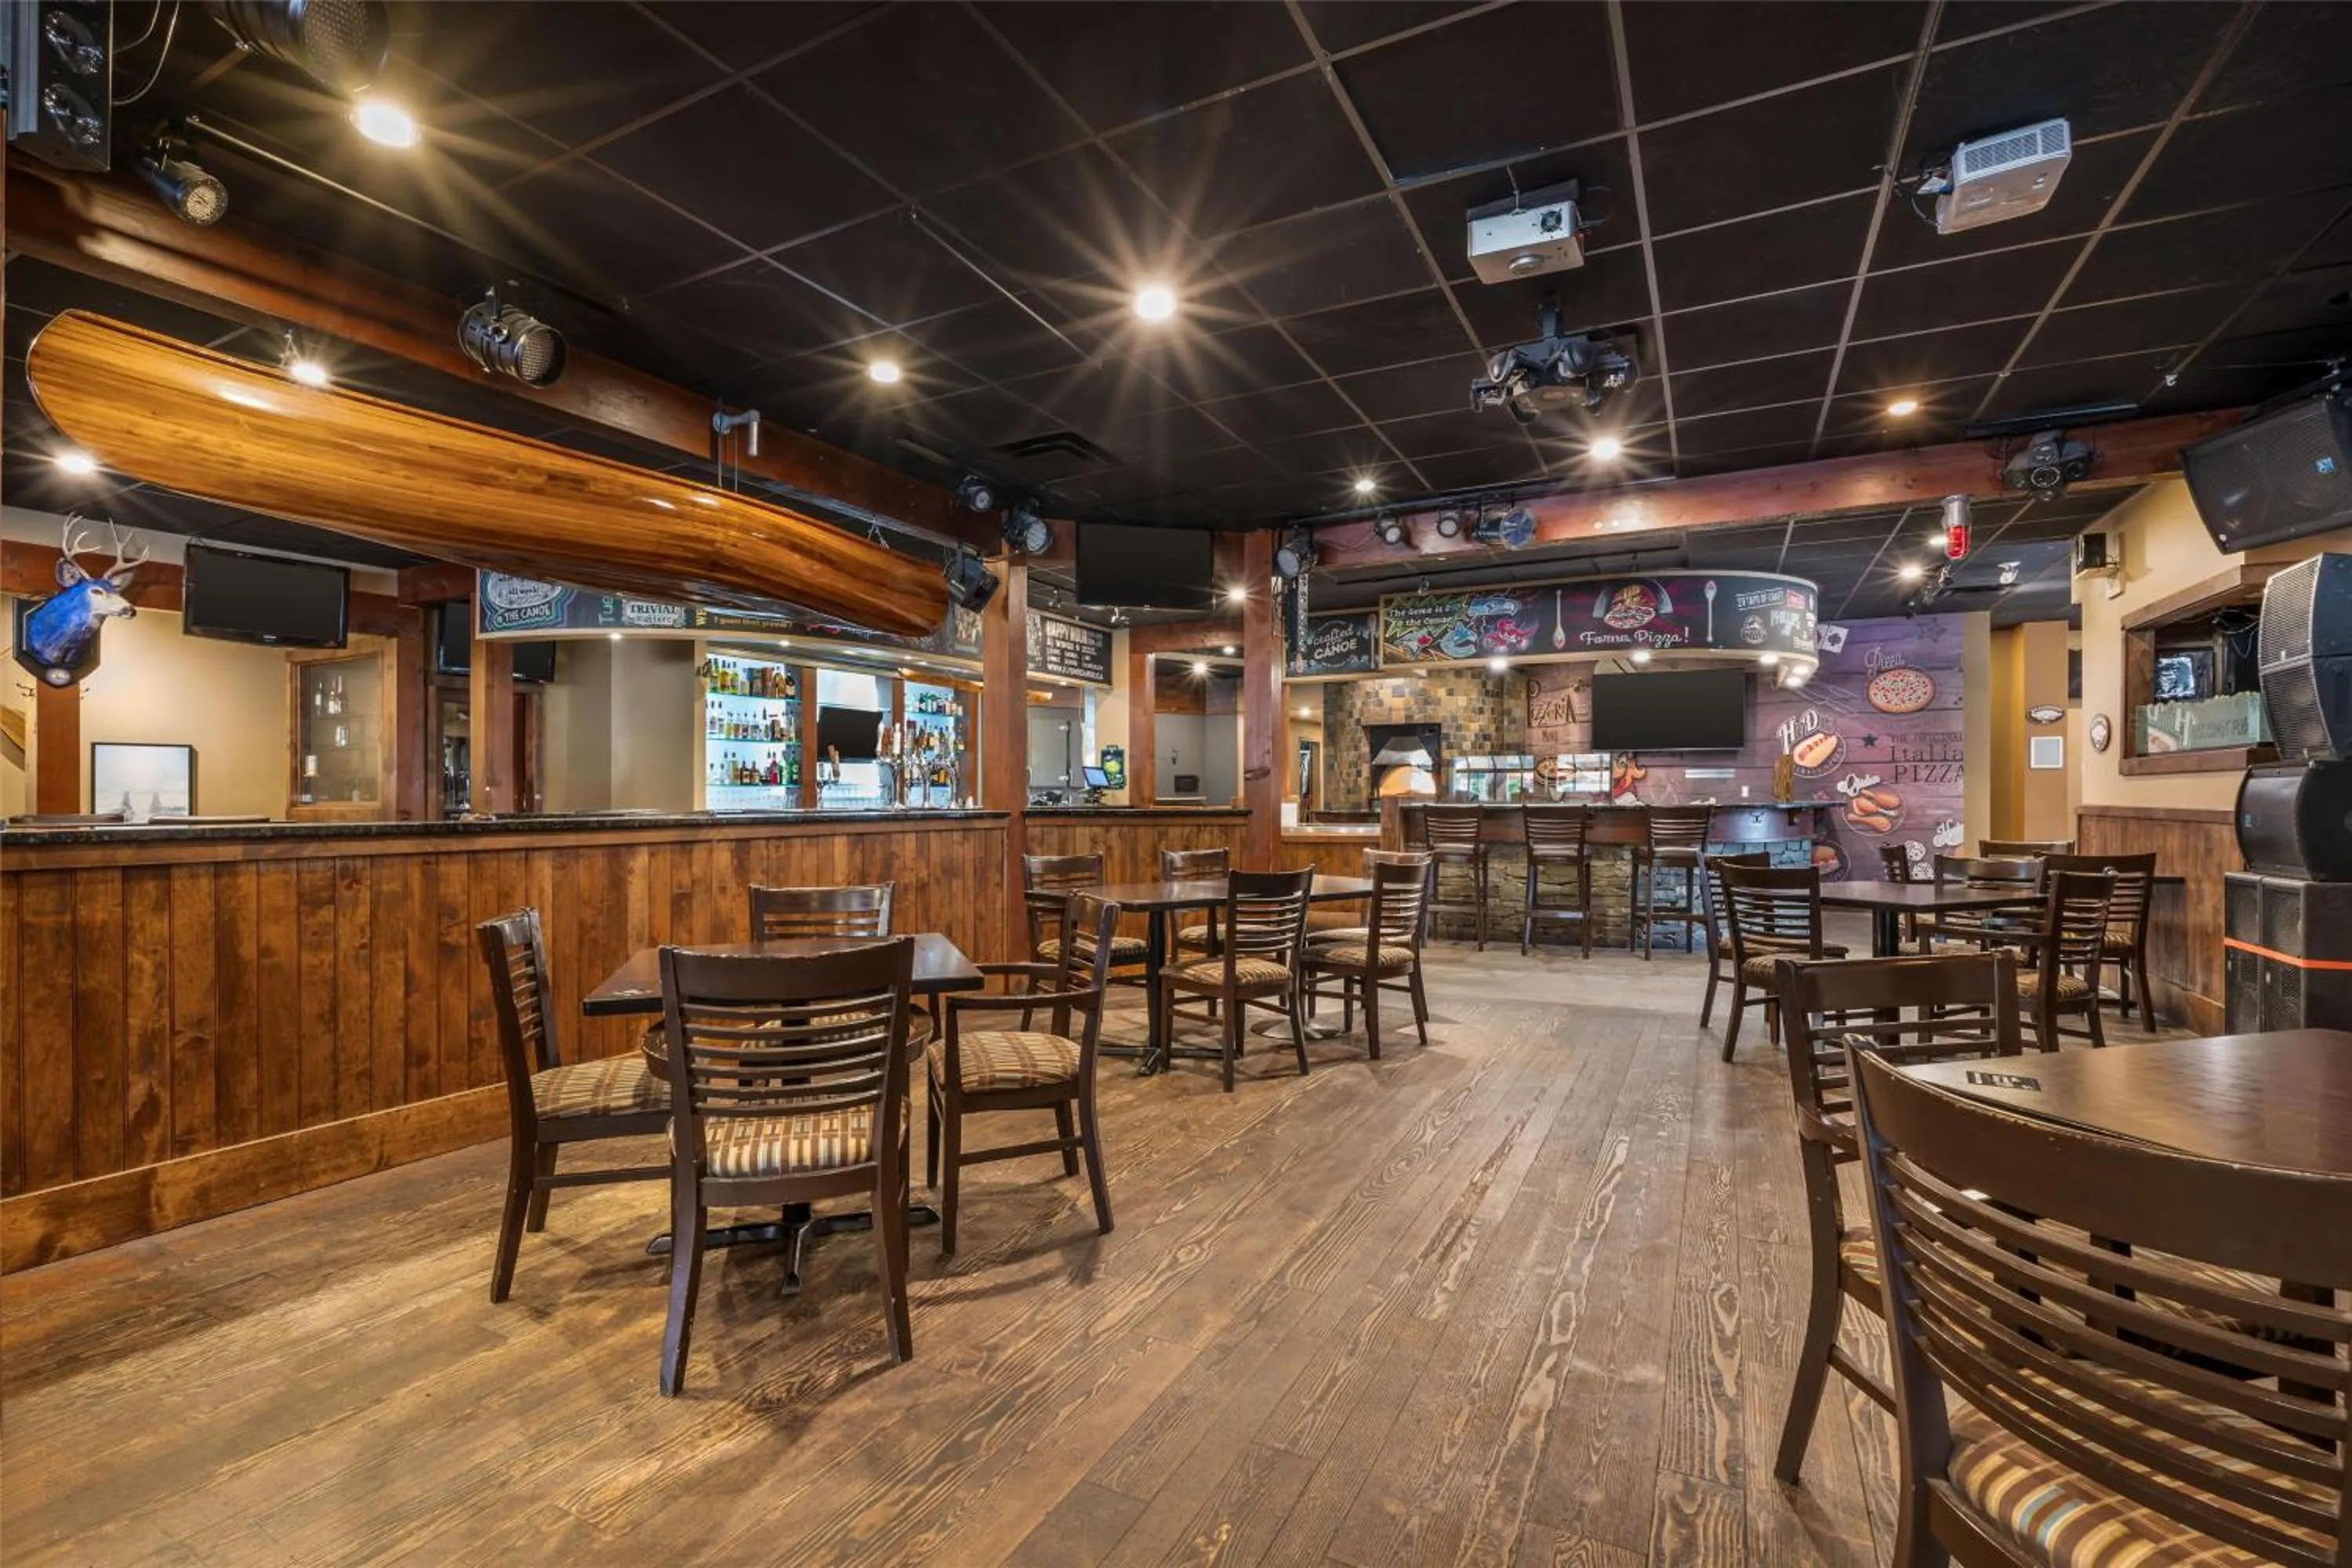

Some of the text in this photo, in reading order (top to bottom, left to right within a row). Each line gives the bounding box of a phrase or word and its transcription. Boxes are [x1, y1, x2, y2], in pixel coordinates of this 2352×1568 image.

[505, 612, 519, 622] THE
[521, 604, 550, 619] CANOE
[1314, 638, 1359, 659] CANOE
[1891, 764, 1963, 785] PIZZA
